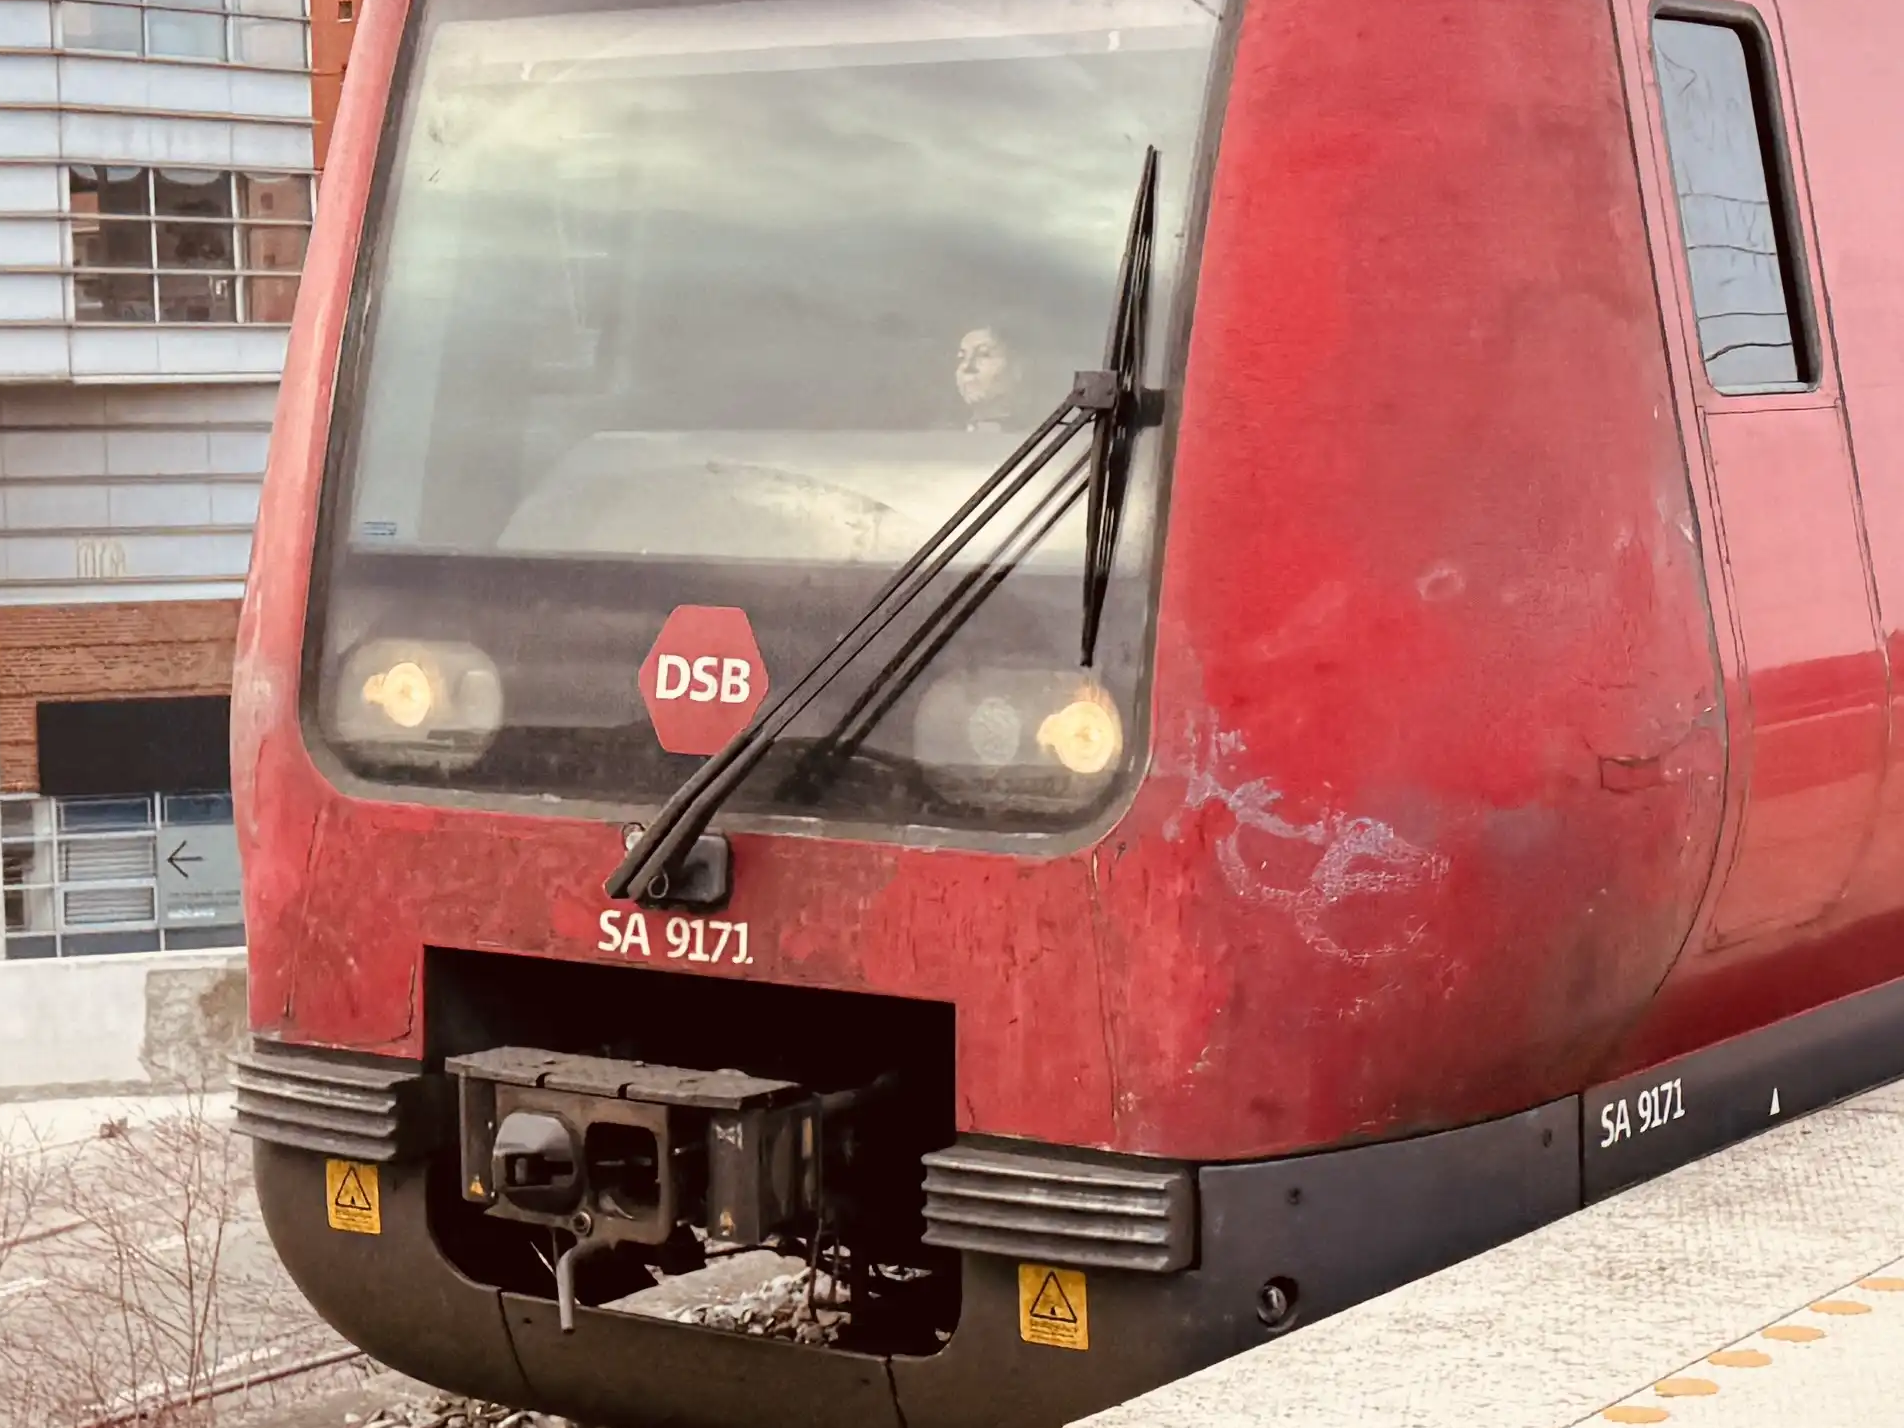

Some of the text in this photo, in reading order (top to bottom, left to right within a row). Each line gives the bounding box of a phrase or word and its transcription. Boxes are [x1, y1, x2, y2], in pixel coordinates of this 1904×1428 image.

[655, 653, 751, 704] DSB
[598, 909, 754, 964] SA 9171
[1600, 1077, 1686, 1148] SA 9171
